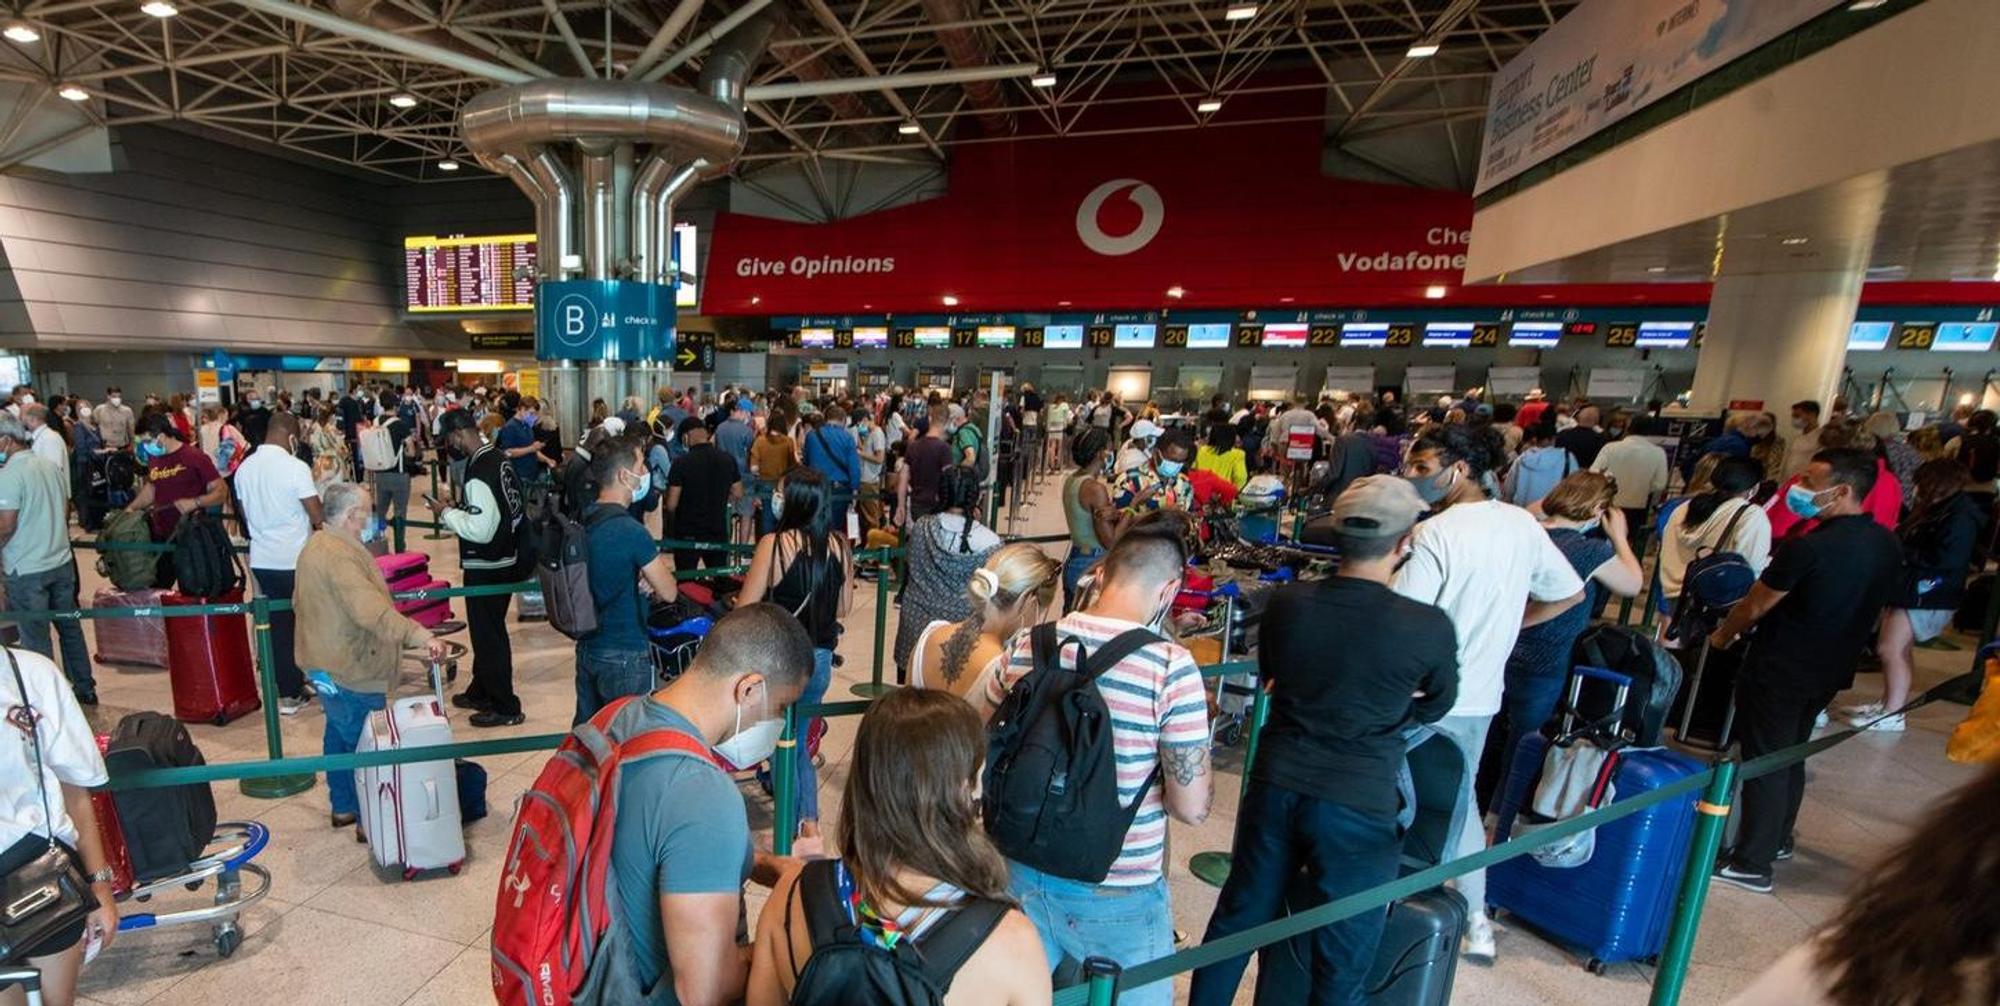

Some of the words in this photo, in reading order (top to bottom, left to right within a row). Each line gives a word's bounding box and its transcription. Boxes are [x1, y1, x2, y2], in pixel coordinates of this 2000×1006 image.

[1546, 54, 1598, 108] Center
[736, 257, 785, 277] Give
[790, 255, 895, 278] Opinions
[1337, 251, 1467, 272] Vodafone
[566, 305, 585, 335] B
[624, 315, 649, 325] check
[836, 333, 850, 345] 15
[898, 333, 912, 345] 16
[957, 332, 973, 344] 17
[1024, 331, 1041, 345] 18
[1091, 330, 1110, 345] 19
[1165, 330, 1186, 344] 20
[1239, 329, 1260, 344] 21
[1312, 330, 1335, 344] 22
[1387, 329, 1411, 344] 23
[1472, 329, 1497, 344] 24
[1609, 329, 1635, 344] 25
[1900, 328, 1931, 347] 28
